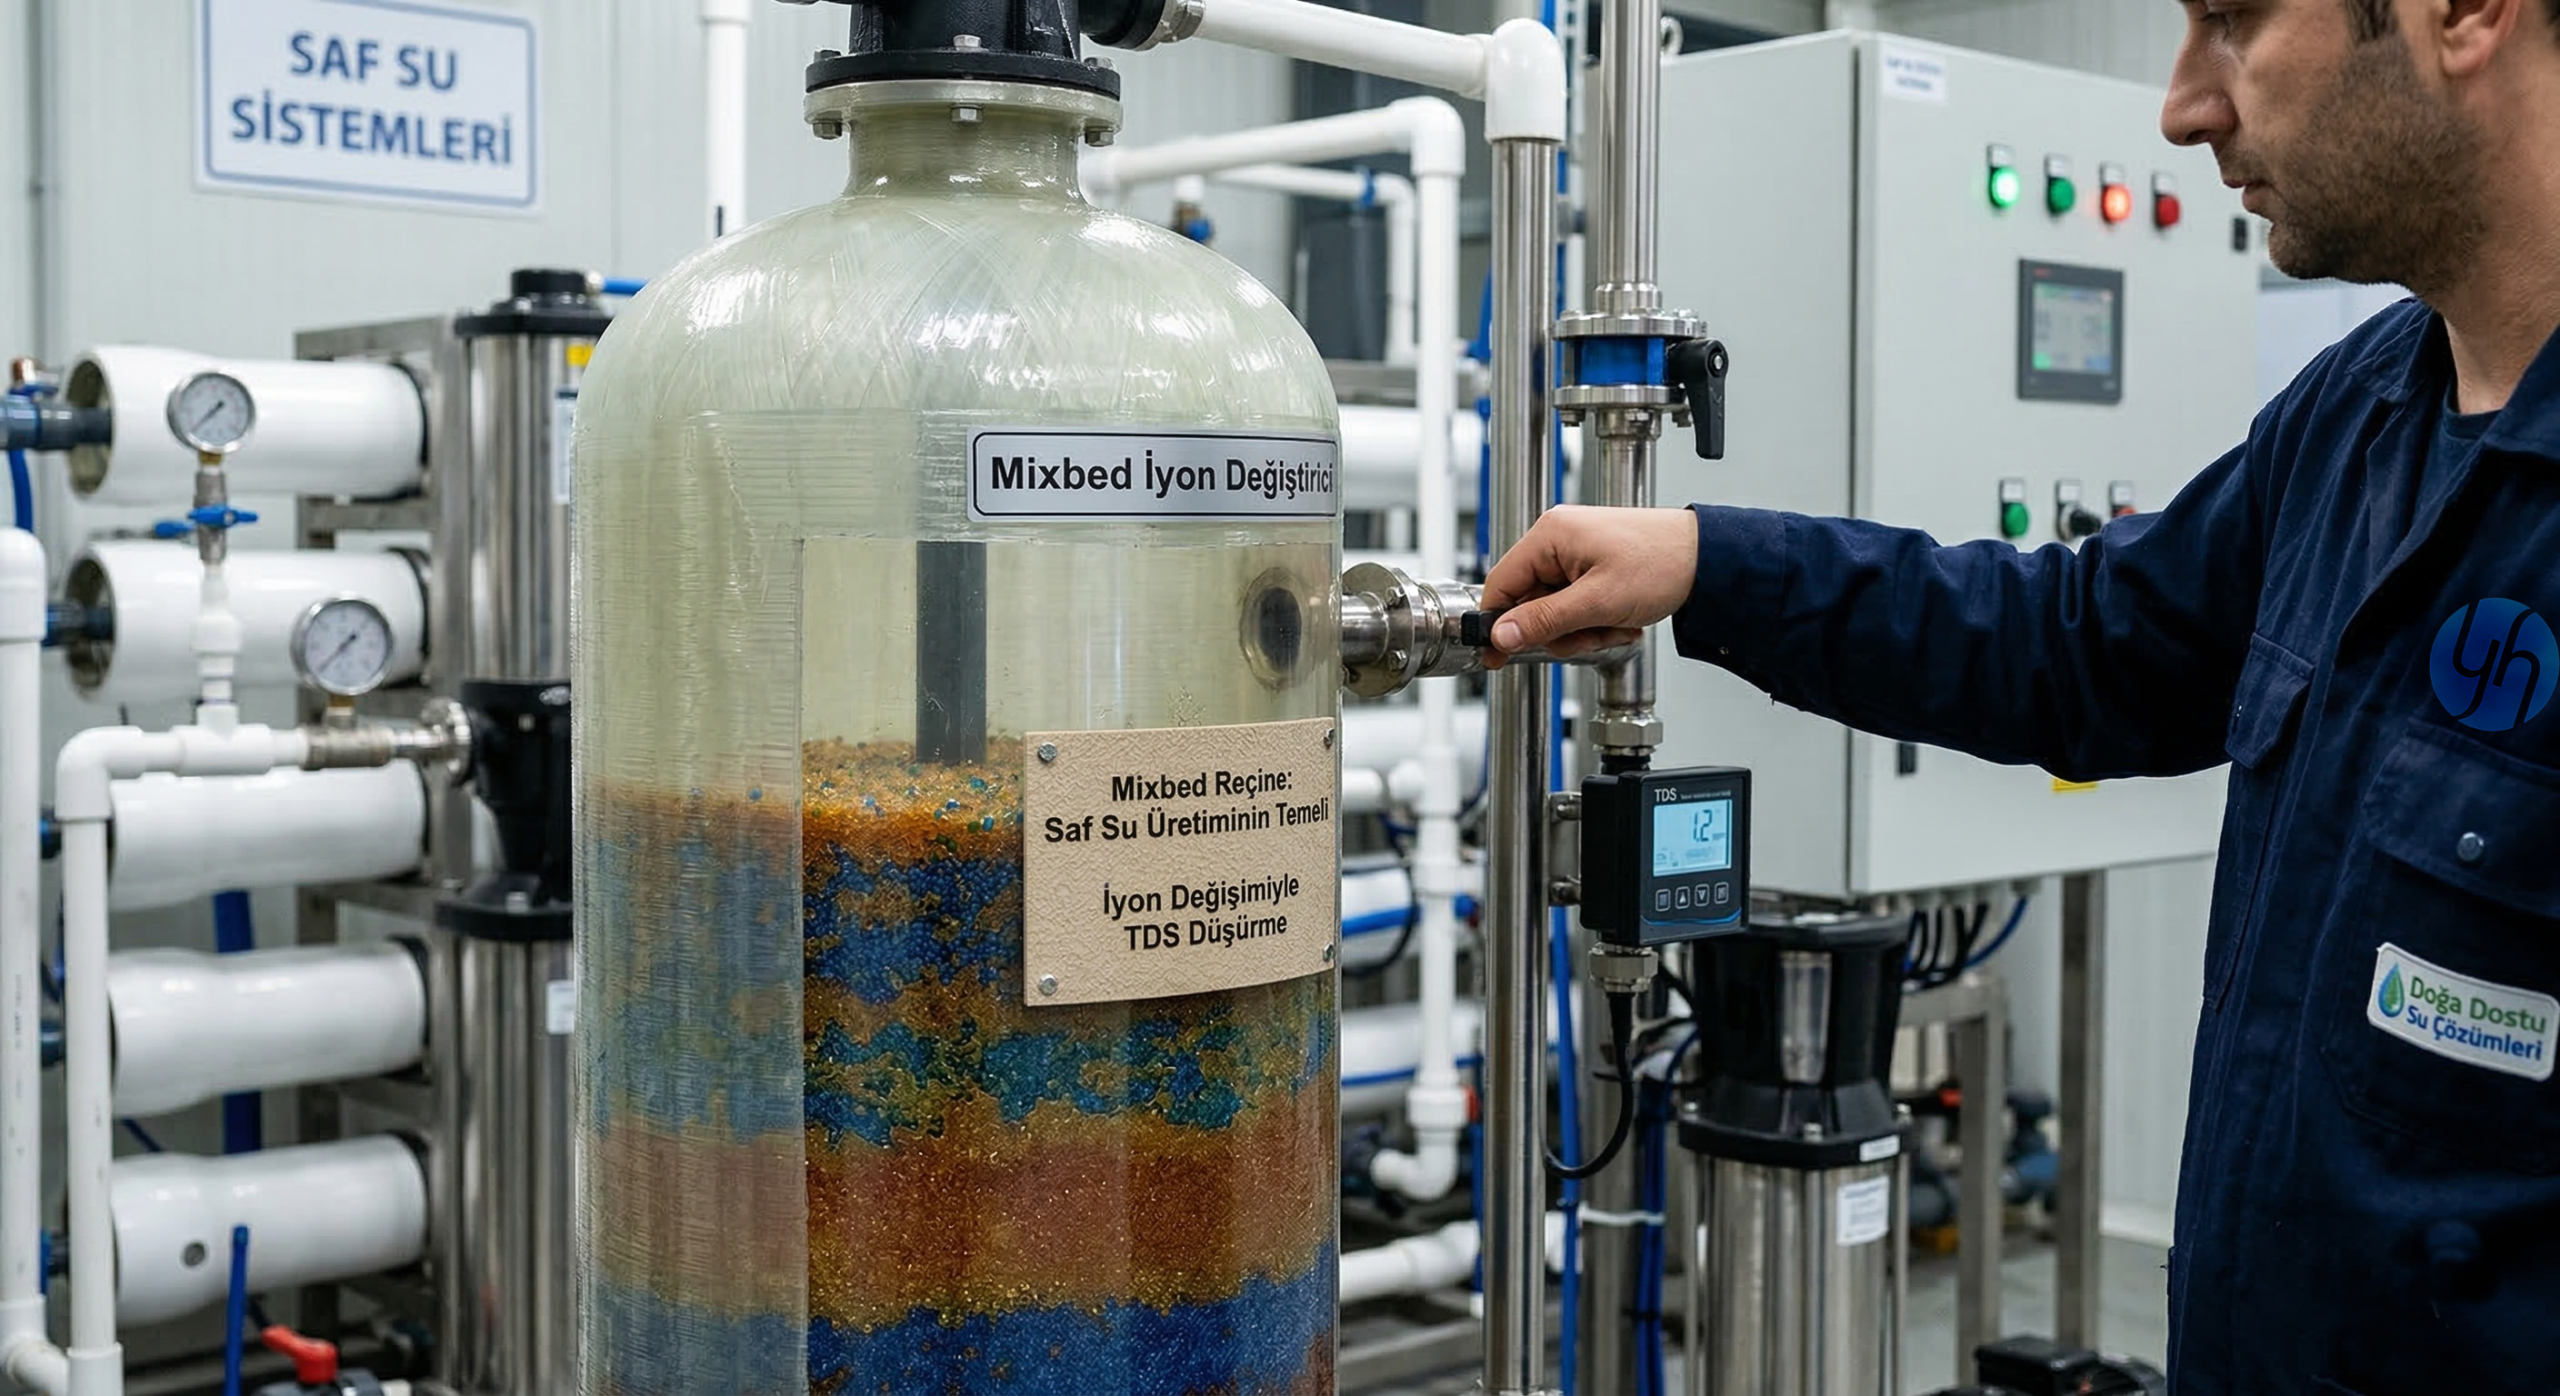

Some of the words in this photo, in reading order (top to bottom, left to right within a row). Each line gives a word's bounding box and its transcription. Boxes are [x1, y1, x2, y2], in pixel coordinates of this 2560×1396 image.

[290, 31, 378, 81] SAF
[399, 45, 457, 90] SU
[231, 90, 512, 165] SİSTEMLERİ
[991, 457, 1131, 490] Mixbed
[1145, 450, 1215, 498] İyon
[1226, 458, 1333, 499] Değiştirici
[1111, 772, 1207, 801] Mixbed
[1215, 768, 1293, 799] Reçine:
[1654, 788, 1677, 802] TDS
[1044, 815, 1093, 842] Saf
[1101, 814, 1138, 840] Su
[1148, 807, 1270, 838] Üretiminin
[1276, 797, 1329, 827] Temeli
[1103, 883, 1162, 920] İyon
[1171, 873, 1299, 913] Değişimiyle
[1124, 922, 1180, 950] TDS
[1189, 914, 1287, 948] Düşürme
[2410, 976, 2461, 1015] Doğa
[2469, 997, 2546, 1035] Dostu
[2406, 1005, 2428, 1030] Su
[2433, 1015, 2543, 1061] Çözümleri
